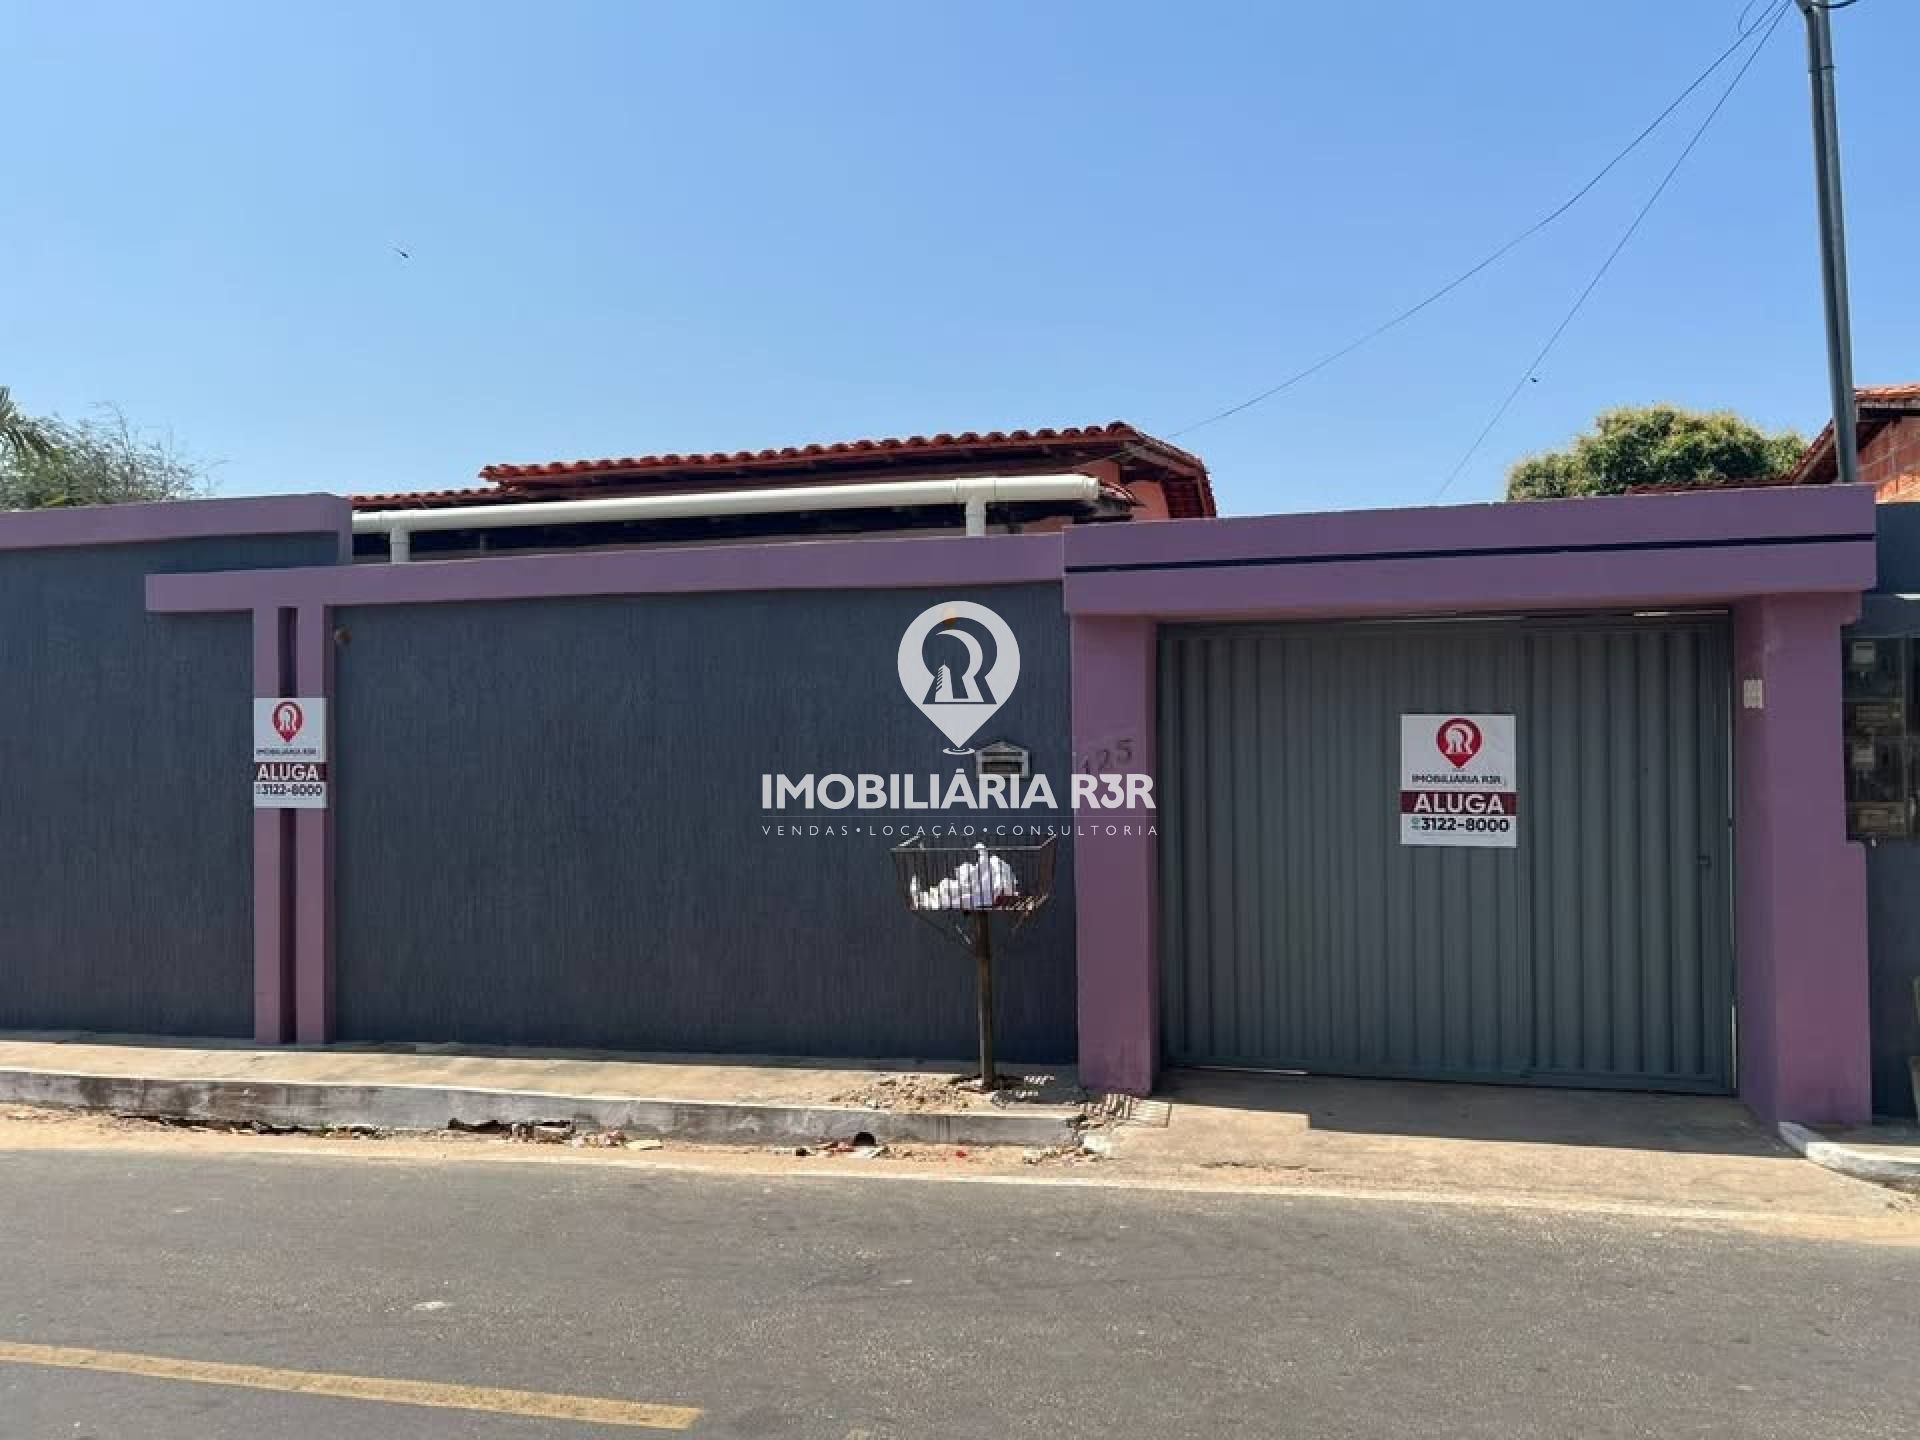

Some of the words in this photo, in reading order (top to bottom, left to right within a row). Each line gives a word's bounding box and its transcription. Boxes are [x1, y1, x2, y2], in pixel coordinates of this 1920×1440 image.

[257, 763, 319, 781] ALUGA
[262, 783, 322, 796] 3122-8000
[1413, 793, 1505, 814] ALUGA
[1421, 817, 1510, 832] 3122-8000
